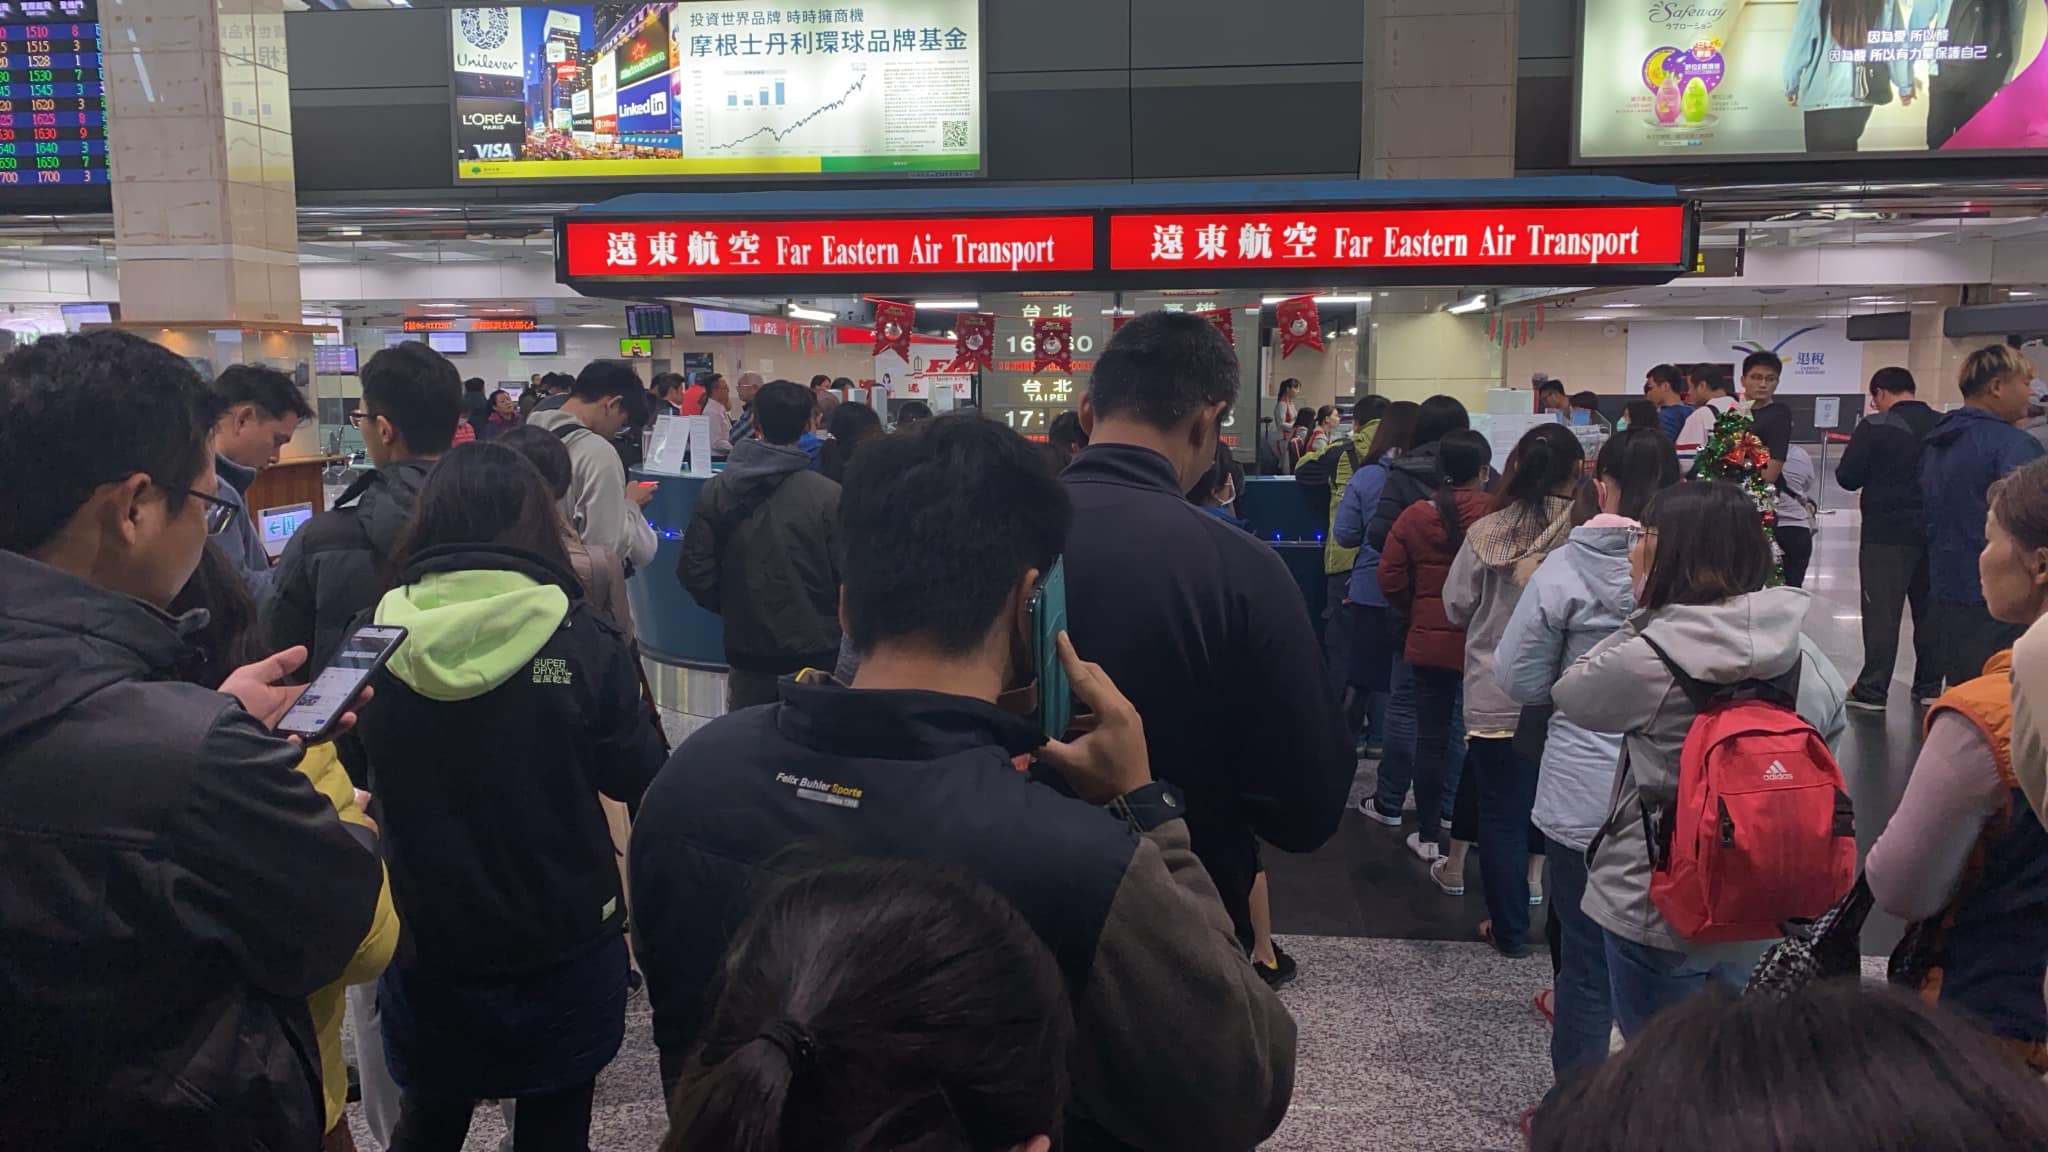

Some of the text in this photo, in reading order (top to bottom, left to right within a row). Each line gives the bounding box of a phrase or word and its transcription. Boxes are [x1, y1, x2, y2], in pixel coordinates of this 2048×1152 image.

[690, 8, 865, 27] 投資世界品牌 時時擁商機
[1649, 2, 1728, 23] Safeway
[26, 26, 48, 38] 1510
[27, 41, 49, 52] 1515
[73, 40, 80, 52] 3
[690, 26, 967, 58] 摩根士丹利環球品牌基金
[75, 55, 80, 66] 1
[457, 53, 519, 70] Unilever
[29, 70, 52, 82] 1530
[74, 69, 82, 80] 7
[30, 85, 53, 96] 1545
[76, 83, 83, 95] 3
[78, 98, 85, 110] 3
[33, 113, 55, 125] 1625
[80, 127, 87, 138] 9
[35, 142, 57, 154] 1640
[81, 141, 88, 153] 3
[473, 143, 513, 158] VISA
[37, 157, 59, 168] 1650
[82, 156, 89, 168] 7
[38, 170, 60, 183] 1700
[83, 170, 90, 182] 3
[1150, 224, 1640, 263] 遠東航空 Far Eastern Air Transport
[606, 231, 1055, 271] 遠東航空 Far Eastern Air Transport
[1022, 304, 1072, 317] 台北
[1022, 379, 1072, 392] 台北
[534, 658, 566, 666] SUPER
[1763, 773, 1793, 781] adidas
[776, 772, 863, 798] Felix Buhler Sports
